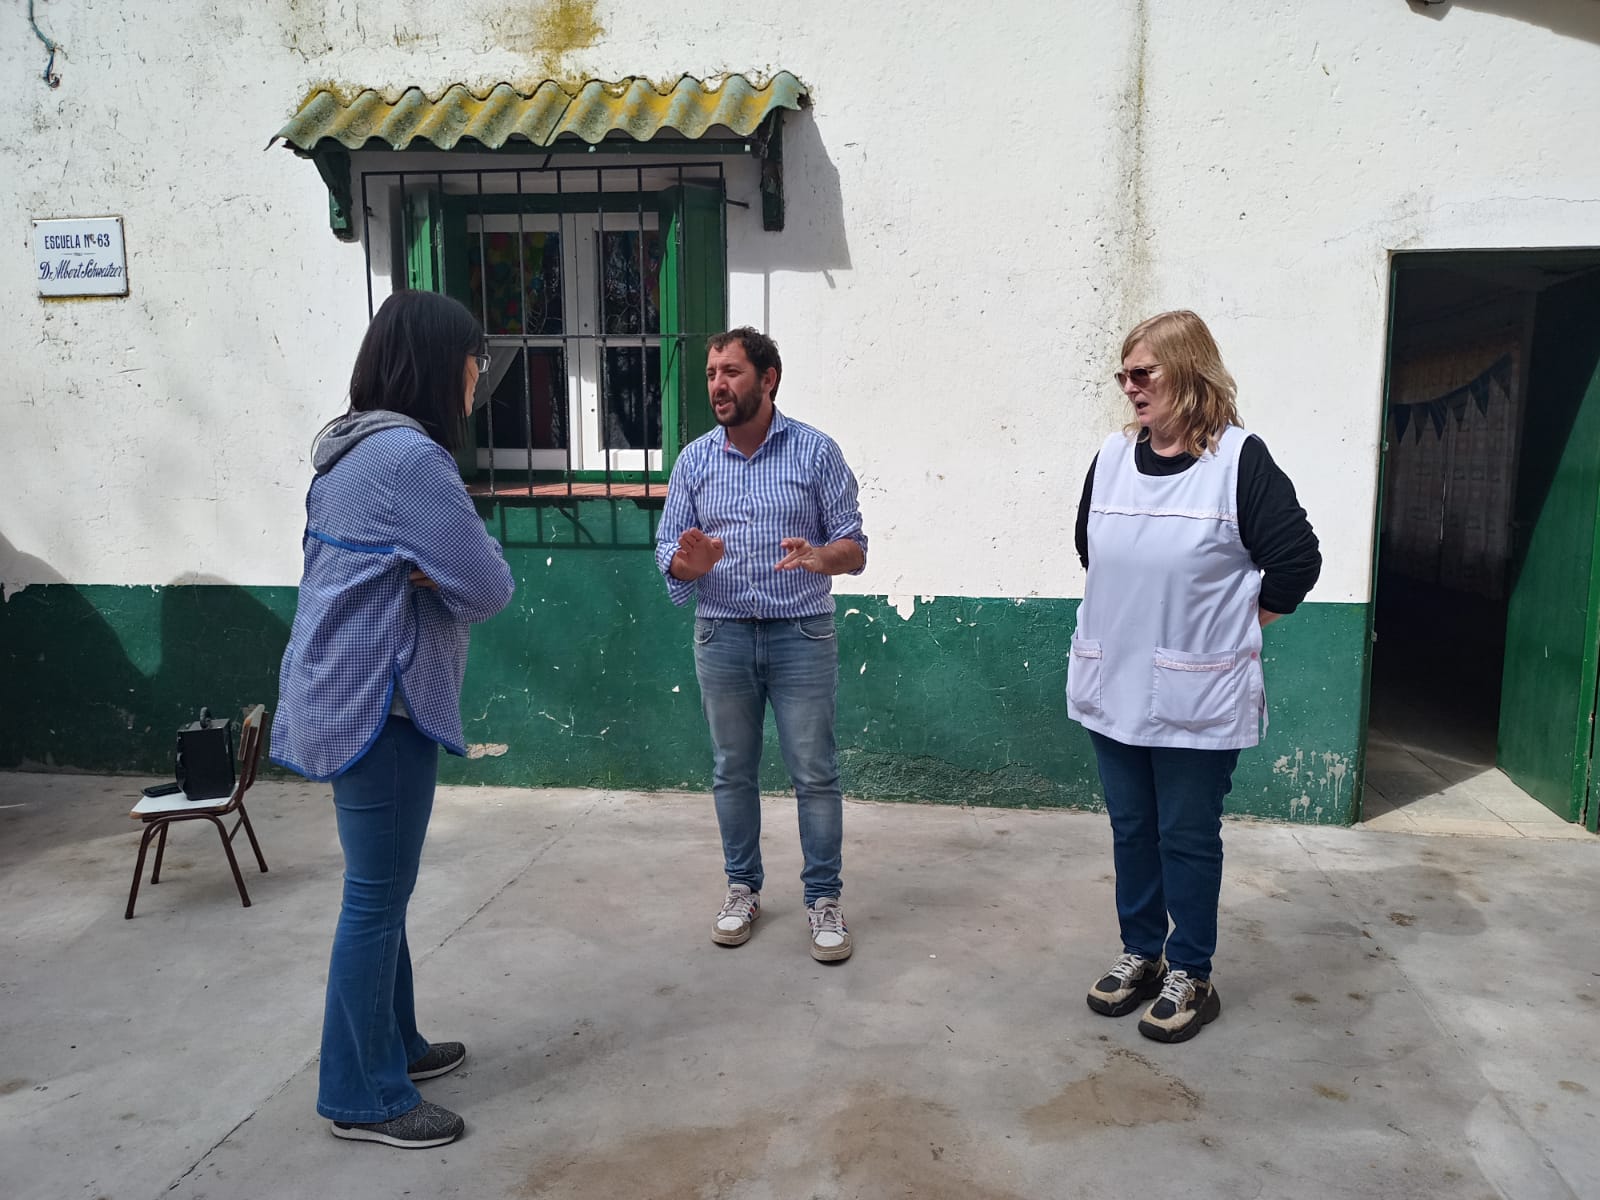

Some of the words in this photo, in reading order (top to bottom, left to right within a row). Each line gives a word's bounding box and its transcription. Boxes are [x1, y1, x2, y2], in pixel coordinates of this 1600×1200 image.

[44, 234, 81, 249] ESCUELA
[97, 233, 110, 248] 63
[53, 259, 83, 281] Albert
